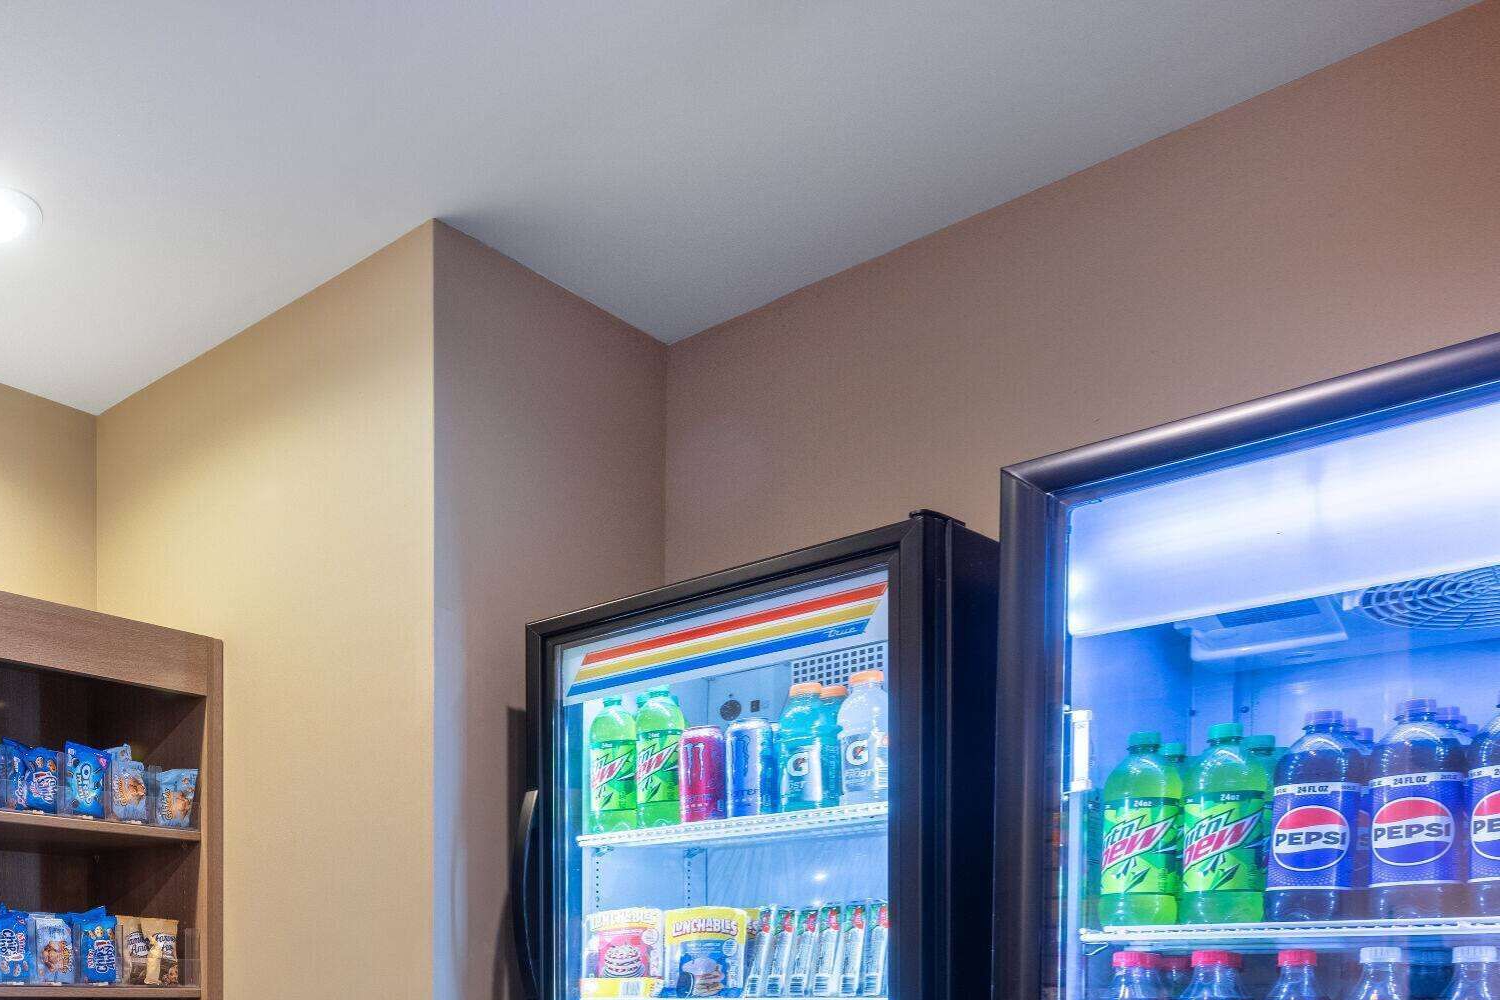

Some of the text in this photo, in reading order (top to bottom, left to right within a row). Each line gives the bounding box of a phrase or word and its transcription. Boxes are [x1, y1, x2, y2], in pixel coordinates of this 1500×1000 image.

[846, 740, 869, 766] G
[788, 752, 810, 777] G
[1393, 777, 1404, 786] 24
[1415, 776, 1427, 784] OZ
[1220, 793, 1240, 801] 24oz
[1276, 831, 1347, 847] PEPSI
[1373, 822, 1451, 842] PEPSI
[672, 918, 738, 937] LUNCHABLES
